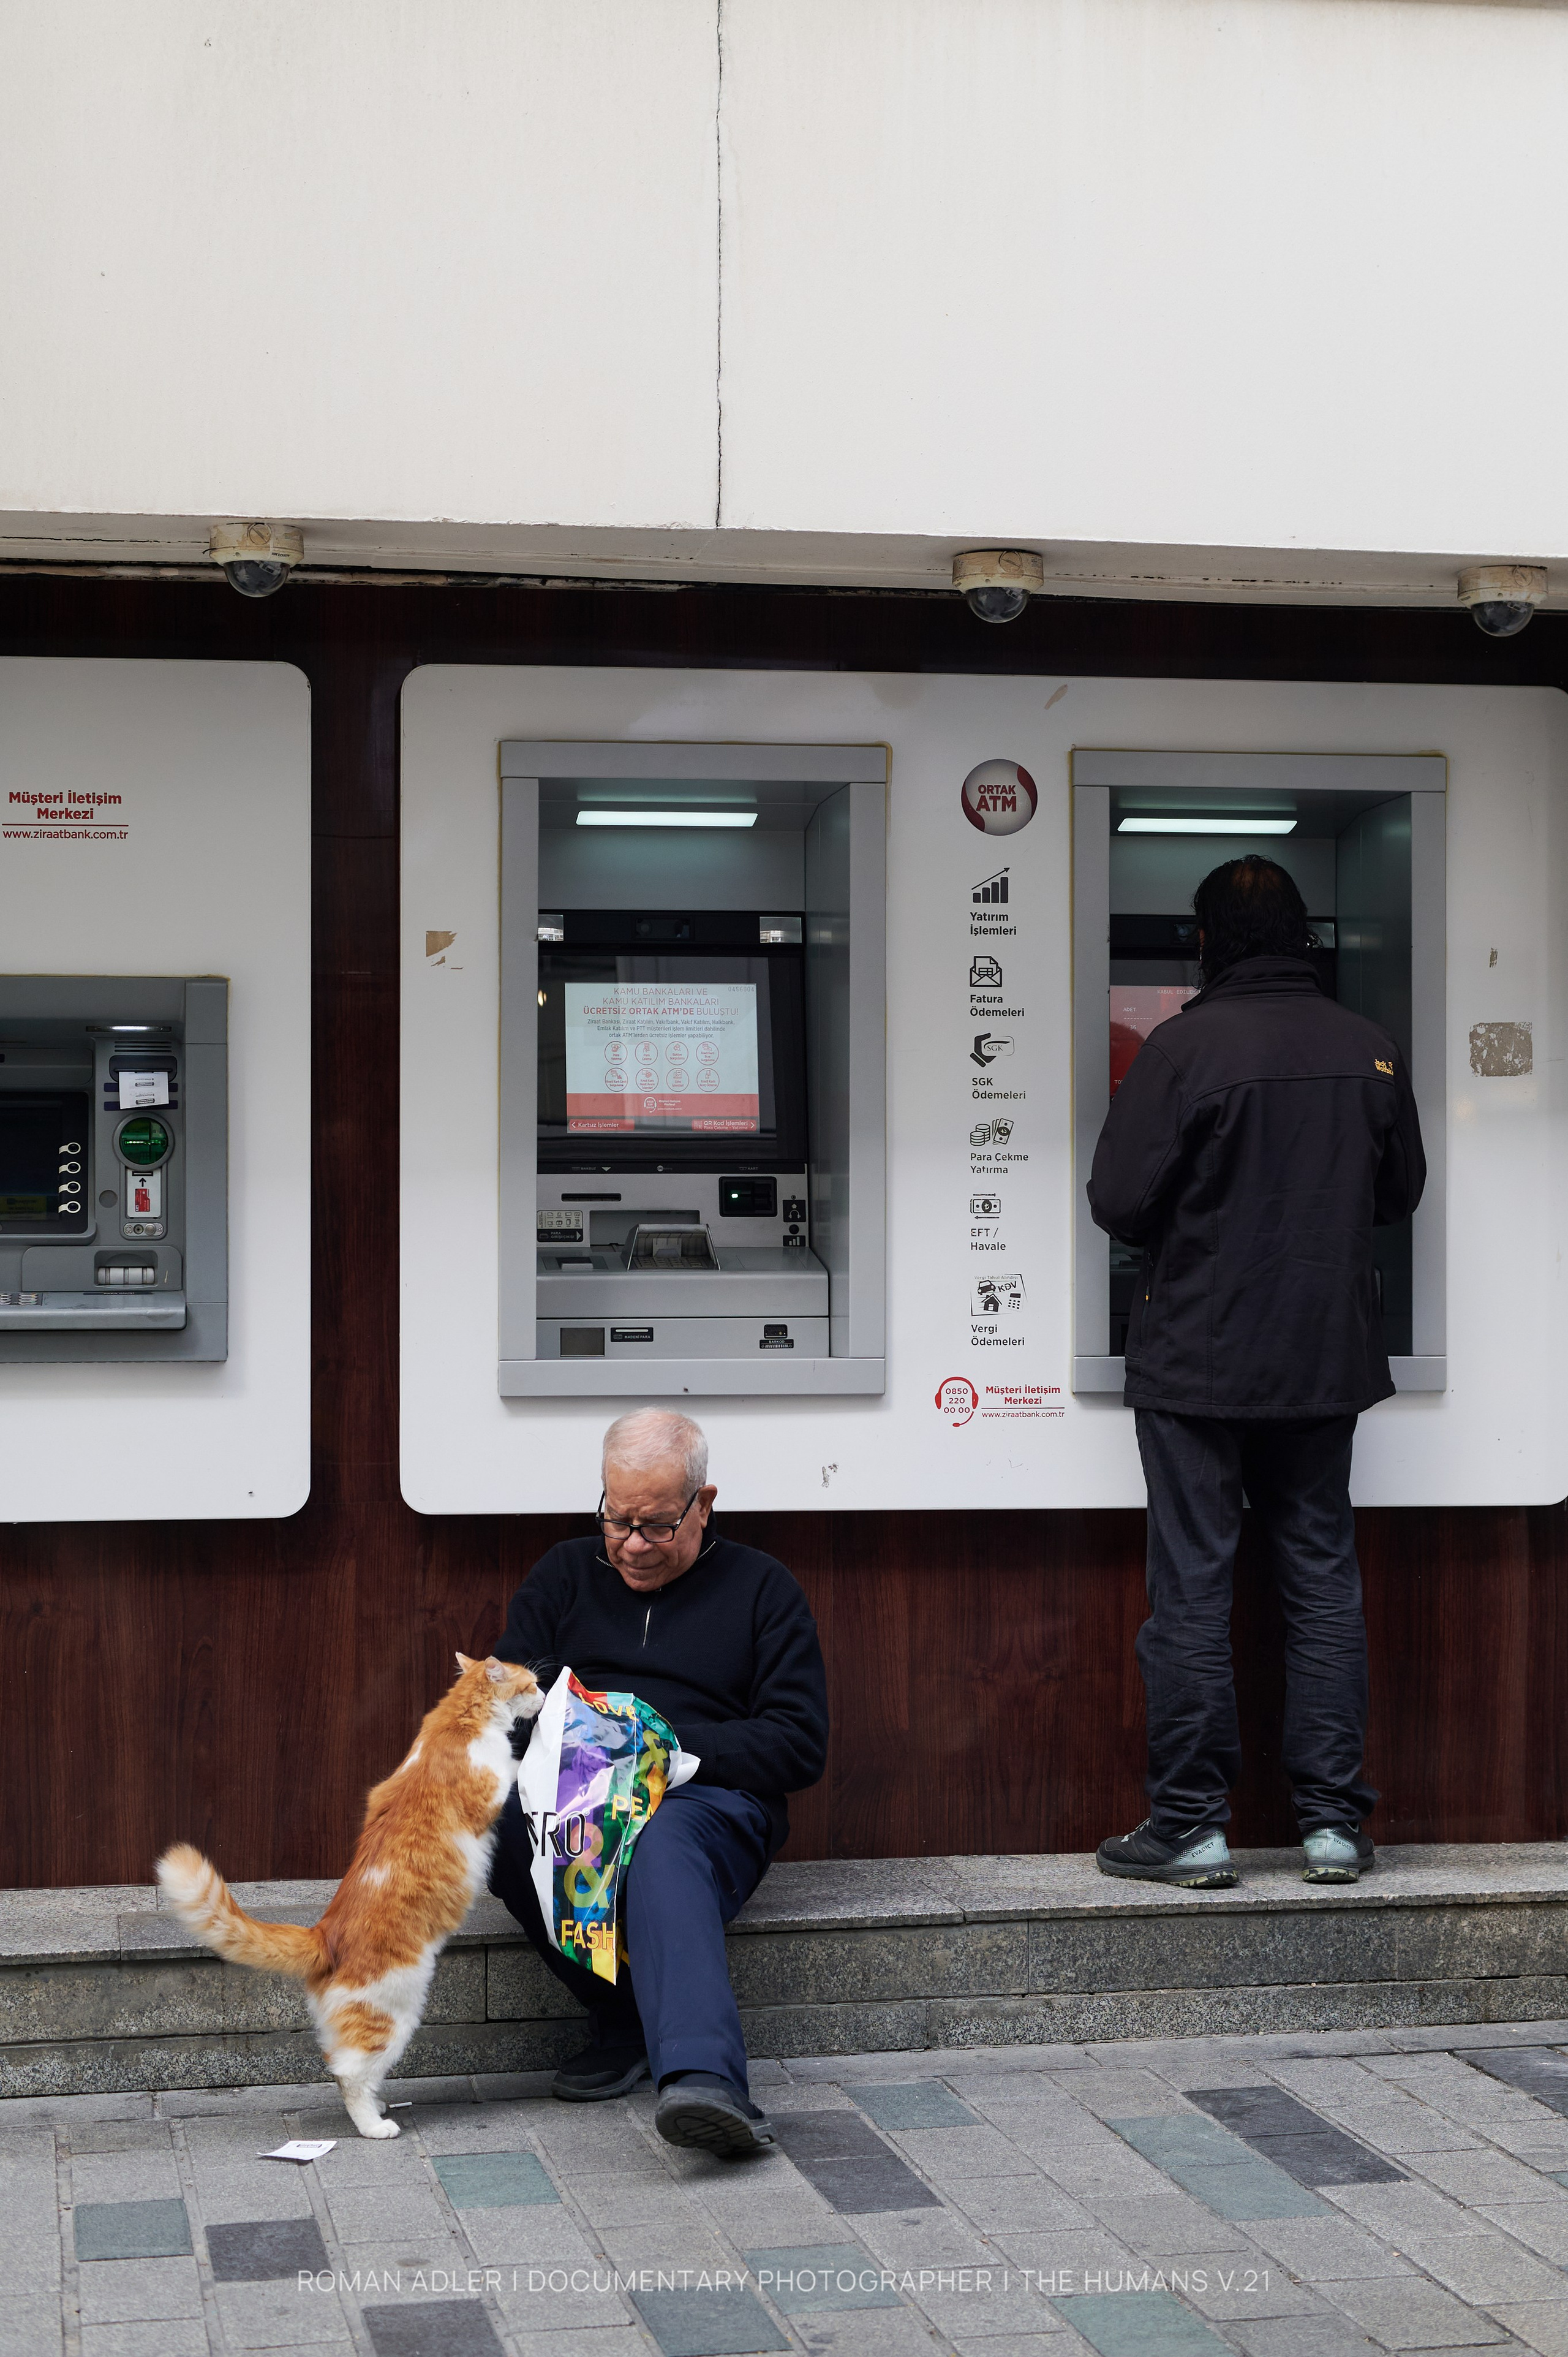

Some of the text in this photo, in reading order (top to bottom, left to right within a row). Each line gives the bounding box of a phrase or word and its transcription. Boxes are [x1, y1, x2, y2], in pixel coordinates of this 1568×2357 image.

[978, 784, 1016, 795] ORTAK
[9, 790, 122, 806] Müşteri İletişim
[976, 795, 1017, 812] ATM
[37, 808, 94, 820] Merkezi
[2, 829, 129, 839] www.ziraatbank.com.tr
[970, 912, 1009, 921] Yatırım
[970, 925, 1017, 936] İşlemleri
[970, 994, 1003, 1004] Fatura
[583, 1006, 627, 1015] ÜCRETSİZ
[697, 1008, 739, 1016] BULUŞTU!
[970, 1005, 1025, 1017] Ödemeleri
[972, 1077, 993, 1086] SGK
[972, 1089, 1026, 1099] Ödemeleri
[971, 1152, 1028, 1163] Para Çekme
[970, 1165, 1008, 1174] Yatırma
[971, 1228, 998, 1238] EFT /
[971, 1241, 1006, 1250] Havale
[997, 1281, 1017, 1292] KDV
[971, 1324, 998, 1334] Vergi
[971, 1336, 1025, 1346] Ödemeleri
[986, 1385, 1061, 1396] Müşteri İletişim
[1004, 1396, 1042, 1405] Merkezi
[578, 1692, 639, 1722] LOVE
[1191, 1841, 1215, 1858] EVADICT
[1333, 1837, 1352, 1851] EVADICT
[564, 1822, 615, 1909] &
